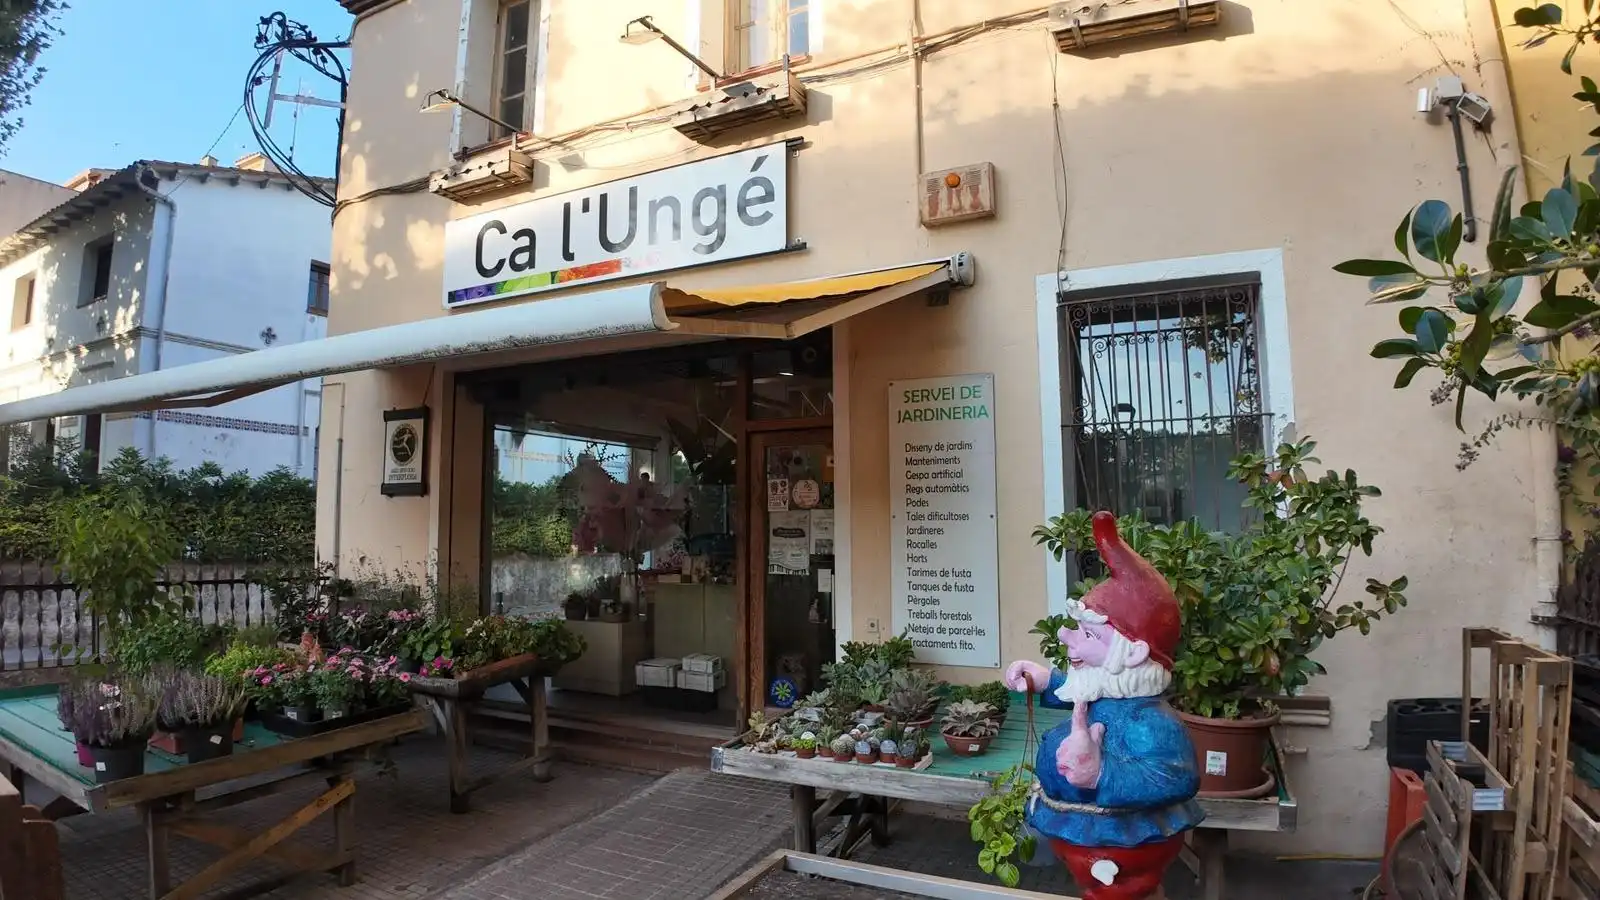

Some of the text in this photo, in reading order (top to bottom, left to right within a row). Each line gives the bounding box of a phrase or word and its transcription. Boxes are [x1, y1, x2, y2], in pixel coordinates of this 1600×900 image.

[475, 154, 775, 278] Ca l'Ungé
[903, 385, 982, 403] SERVEI DE
[897, 405, 989, 423] JARDINERIA
[905, 440, 973, 453] Disseny de jardins
[905, 456, 961, 466] Manteniments
[905, 469, 964, 481] Gespa artificial
[905, 483, 970, 495] Regs automàtics
[906, 498, 929, 507] Podes
[906, 511, 970, 521] Tales dificultoses
[906, 525, 945, 536] Jardineres
[906, 539, 938, 549] Rocalles
[906, 553, 928, 563] Horts
[907, 567, 972, 578] Tarimes de fusta
[907, 581, 975, 593] Tanques de fusta
[907, 595, 940, 606] Pèrgoles
[907, 609, 972, 621] Treballs forestals
[907, 623, 935, 635] Neteja
[936, 624, 947, 634] de
[959, 640, 976, 650] fito.
